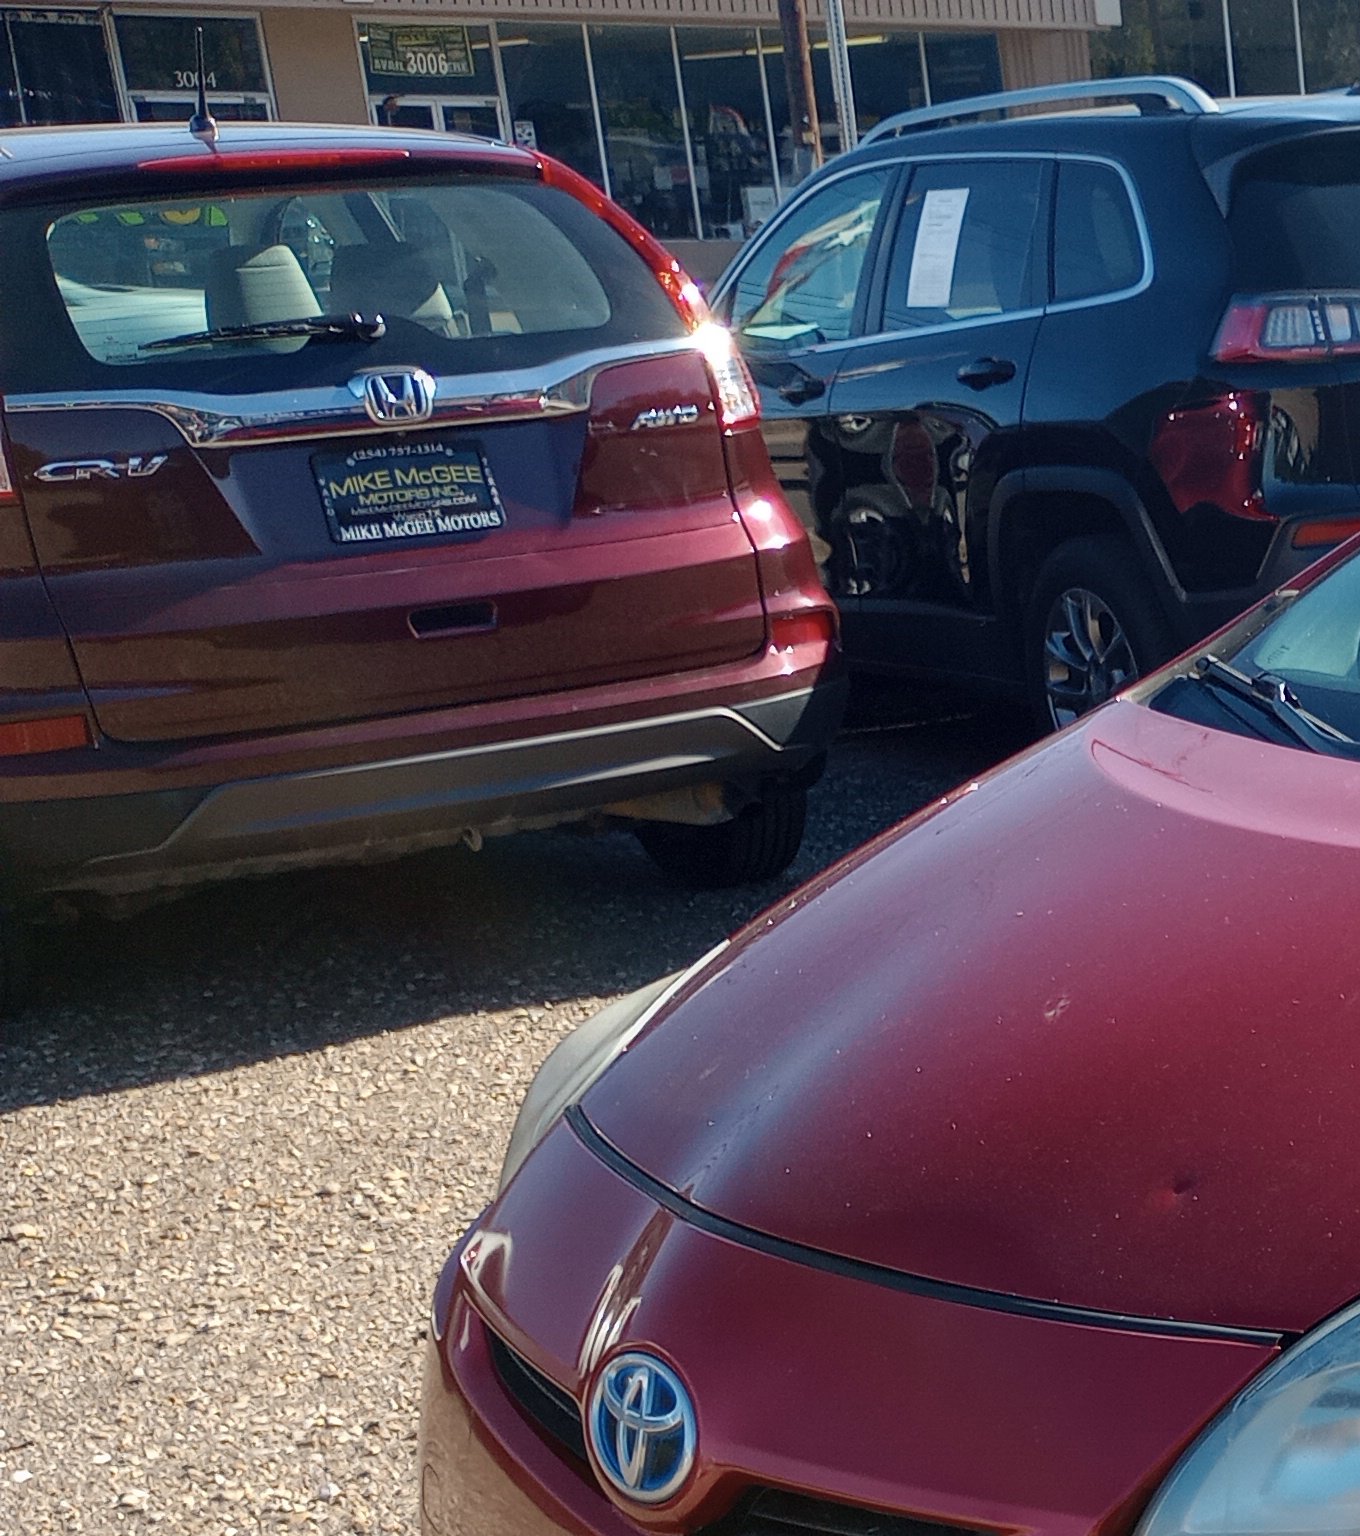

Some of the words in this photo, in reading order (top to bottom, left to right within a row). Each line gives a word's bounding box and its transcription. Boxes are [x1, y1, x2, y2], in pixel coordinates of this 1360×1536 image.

[406, 52, 449, 75] 3006
[631, 404, 699, 431] AWD
[33, 455, 169, 482] CR-V
[329, 470, 393, 499] MIKE
[393, 465, 484, 487] McGEE
[358, 488, 430, 506] MOTORS
[340, 522, 383, 542] MIKE
[437, 510, 501, 529] MOTORS
